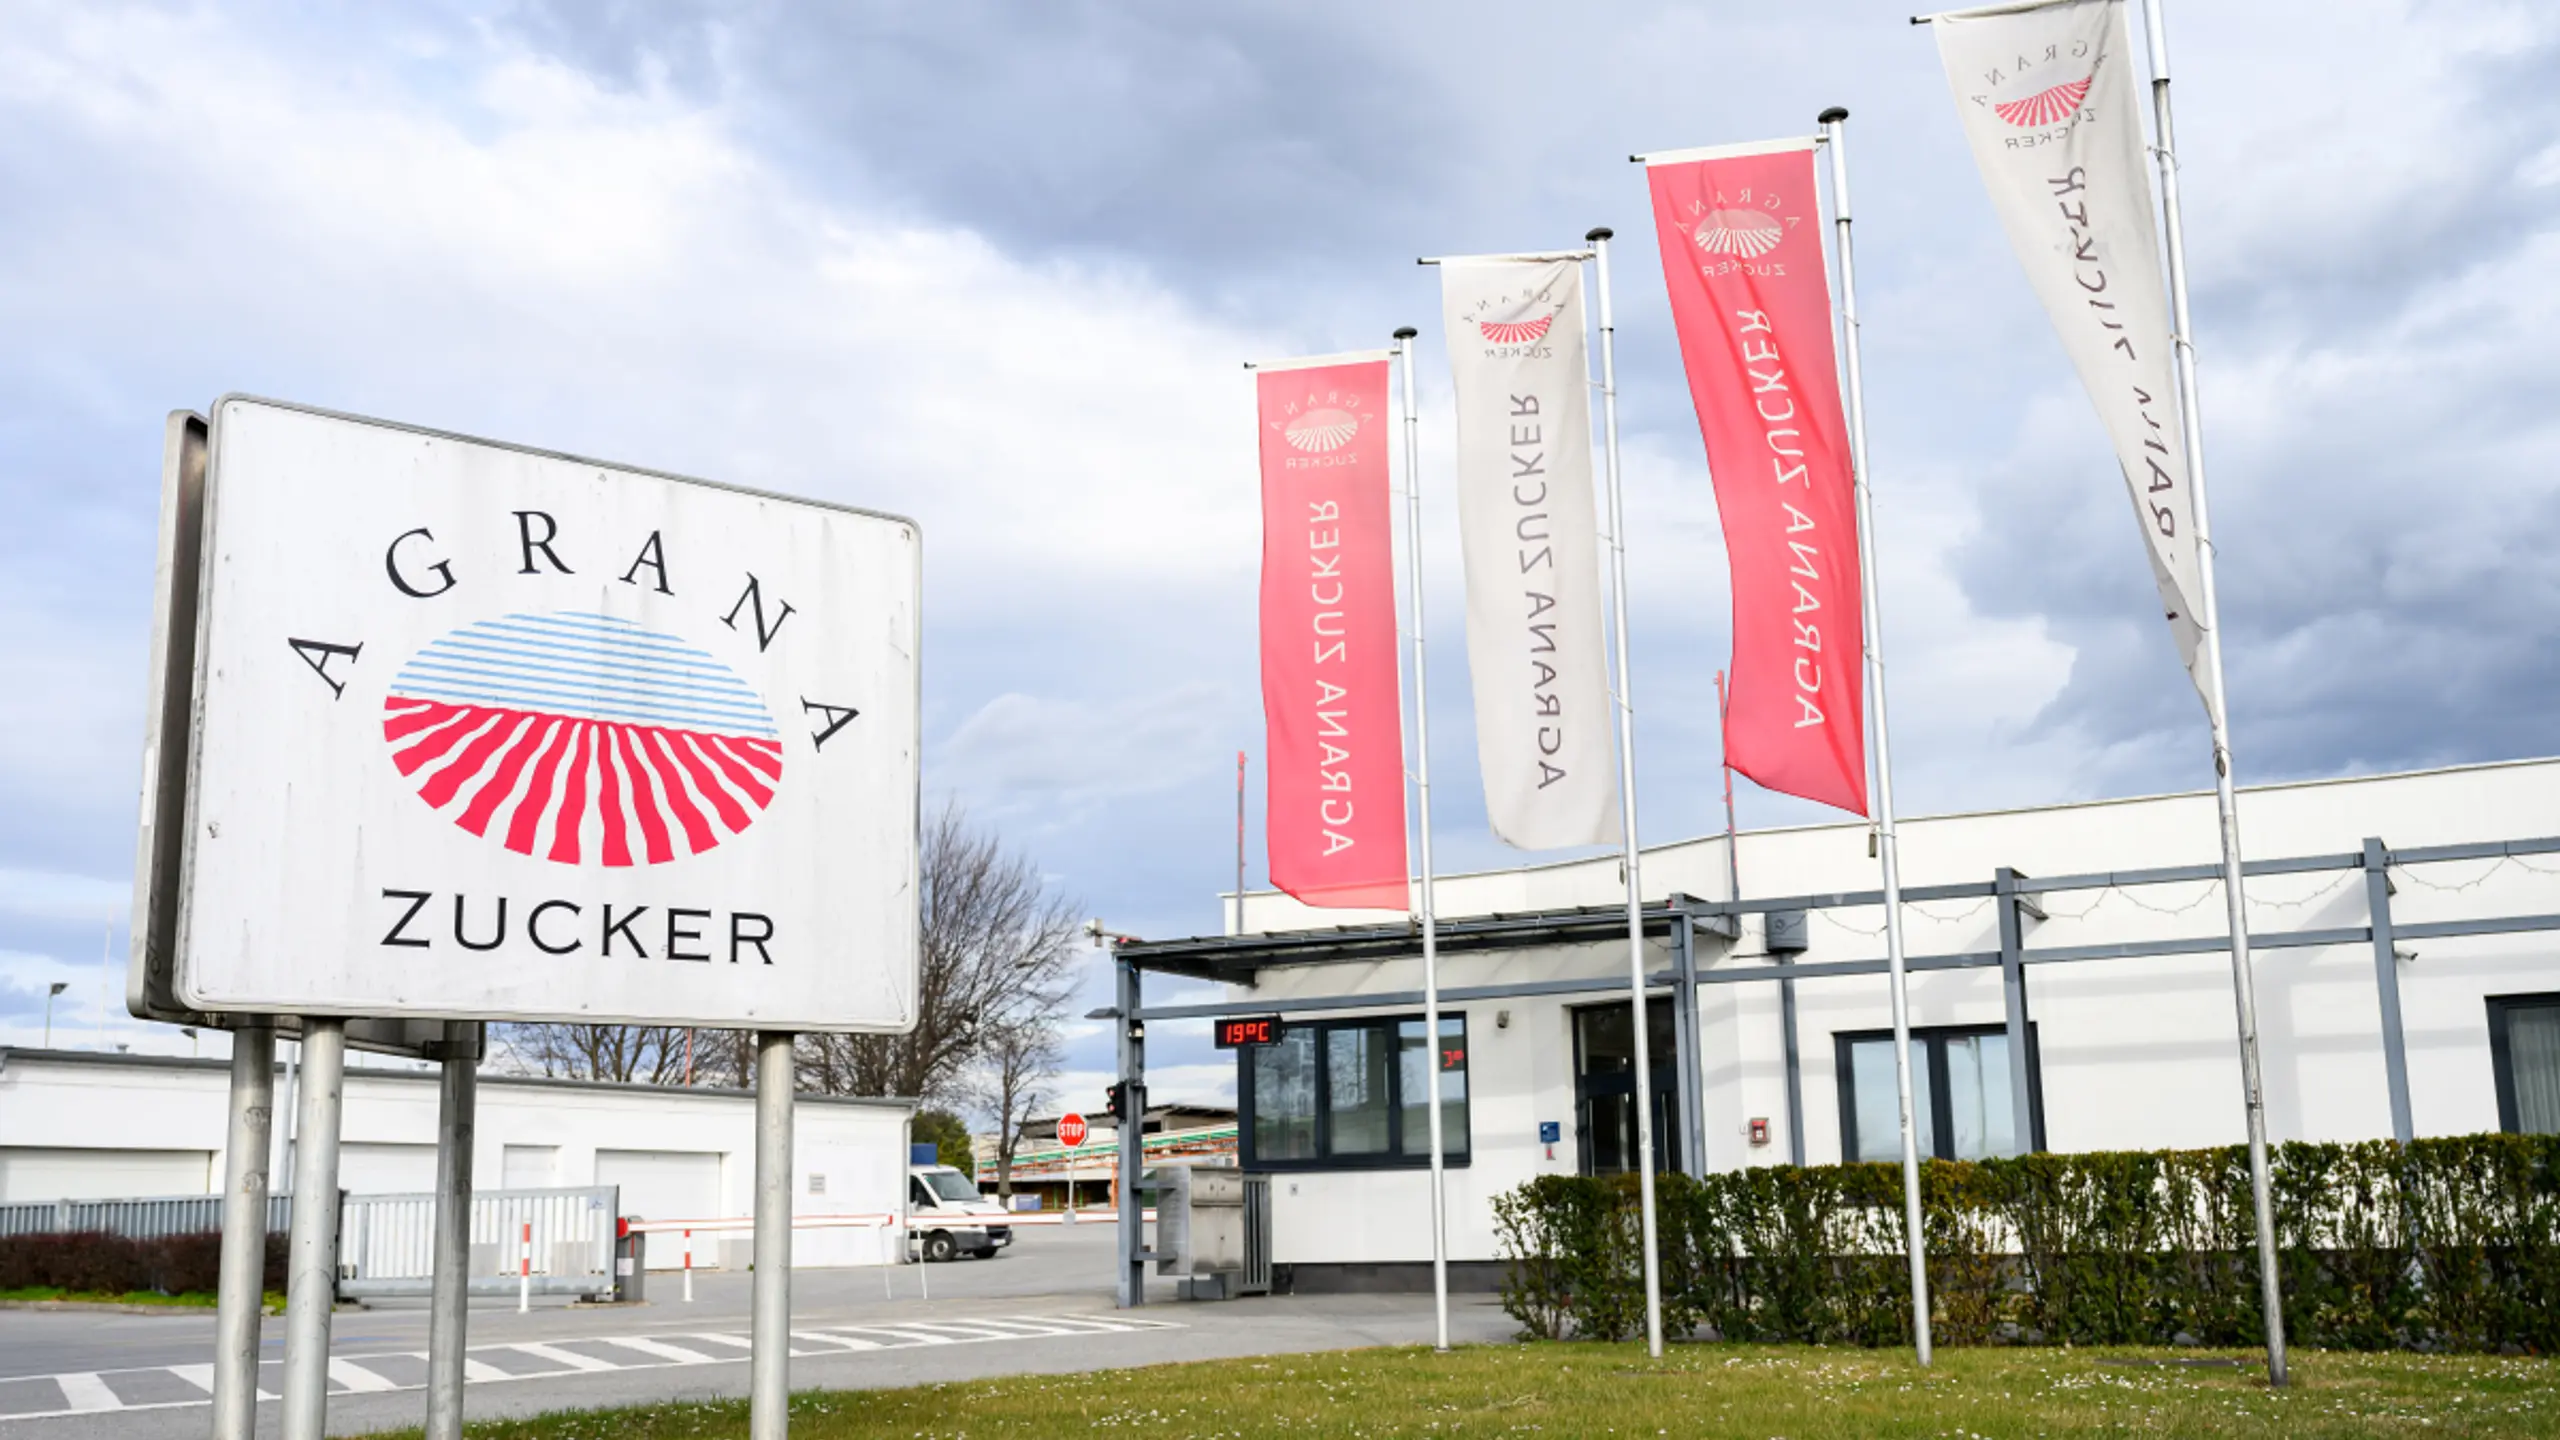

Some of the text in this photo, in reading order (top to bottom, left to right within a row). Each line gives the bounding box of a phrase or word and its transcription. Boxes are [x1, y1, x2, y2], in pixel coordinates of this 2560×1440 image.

[288, 511, 859, 749] AGRANA
[381, 889, 774, 965] ZUCKER
[1060, 1123, 1083, 1137] STOP
